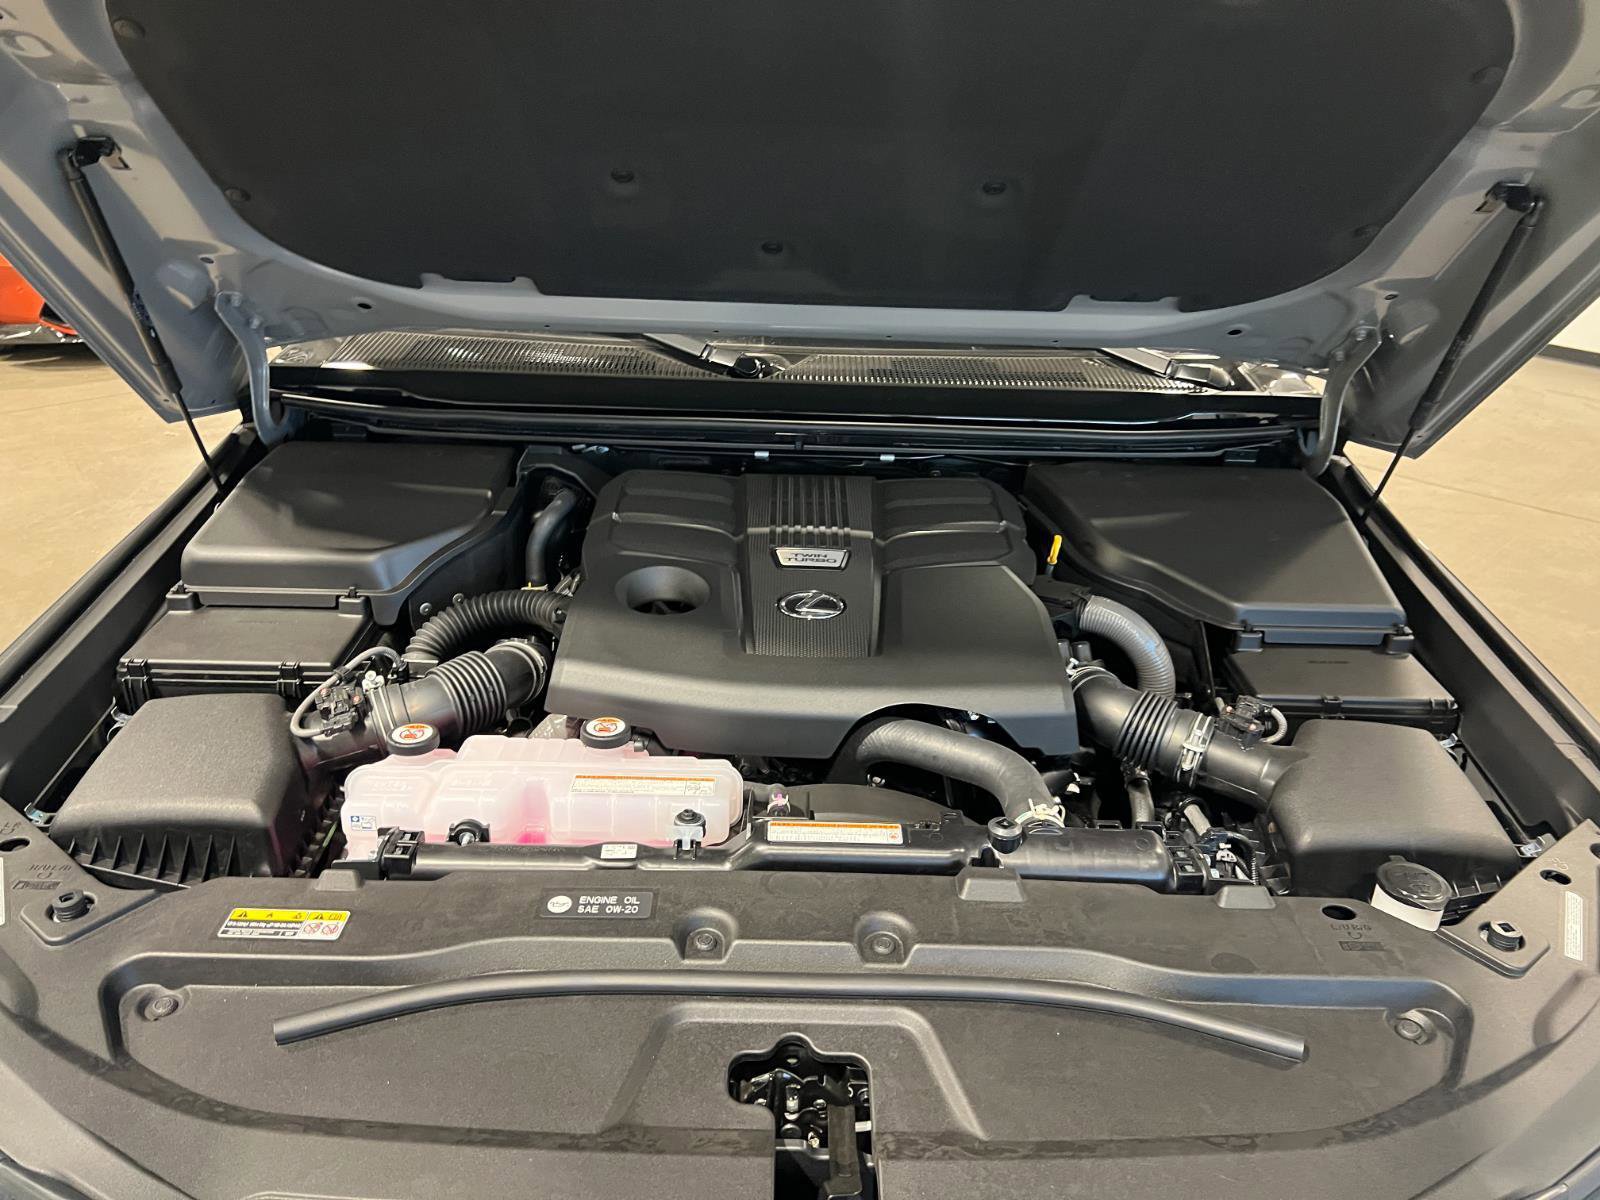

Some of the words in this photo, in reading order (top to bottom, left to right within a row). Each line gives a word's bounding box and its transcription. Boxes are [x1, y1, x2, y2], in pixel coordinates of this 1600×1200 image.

[579, 895, 618, 904] ENGINE
[623, 896, 640, 904] OIL
[577, 905, 600, 914] SAE
